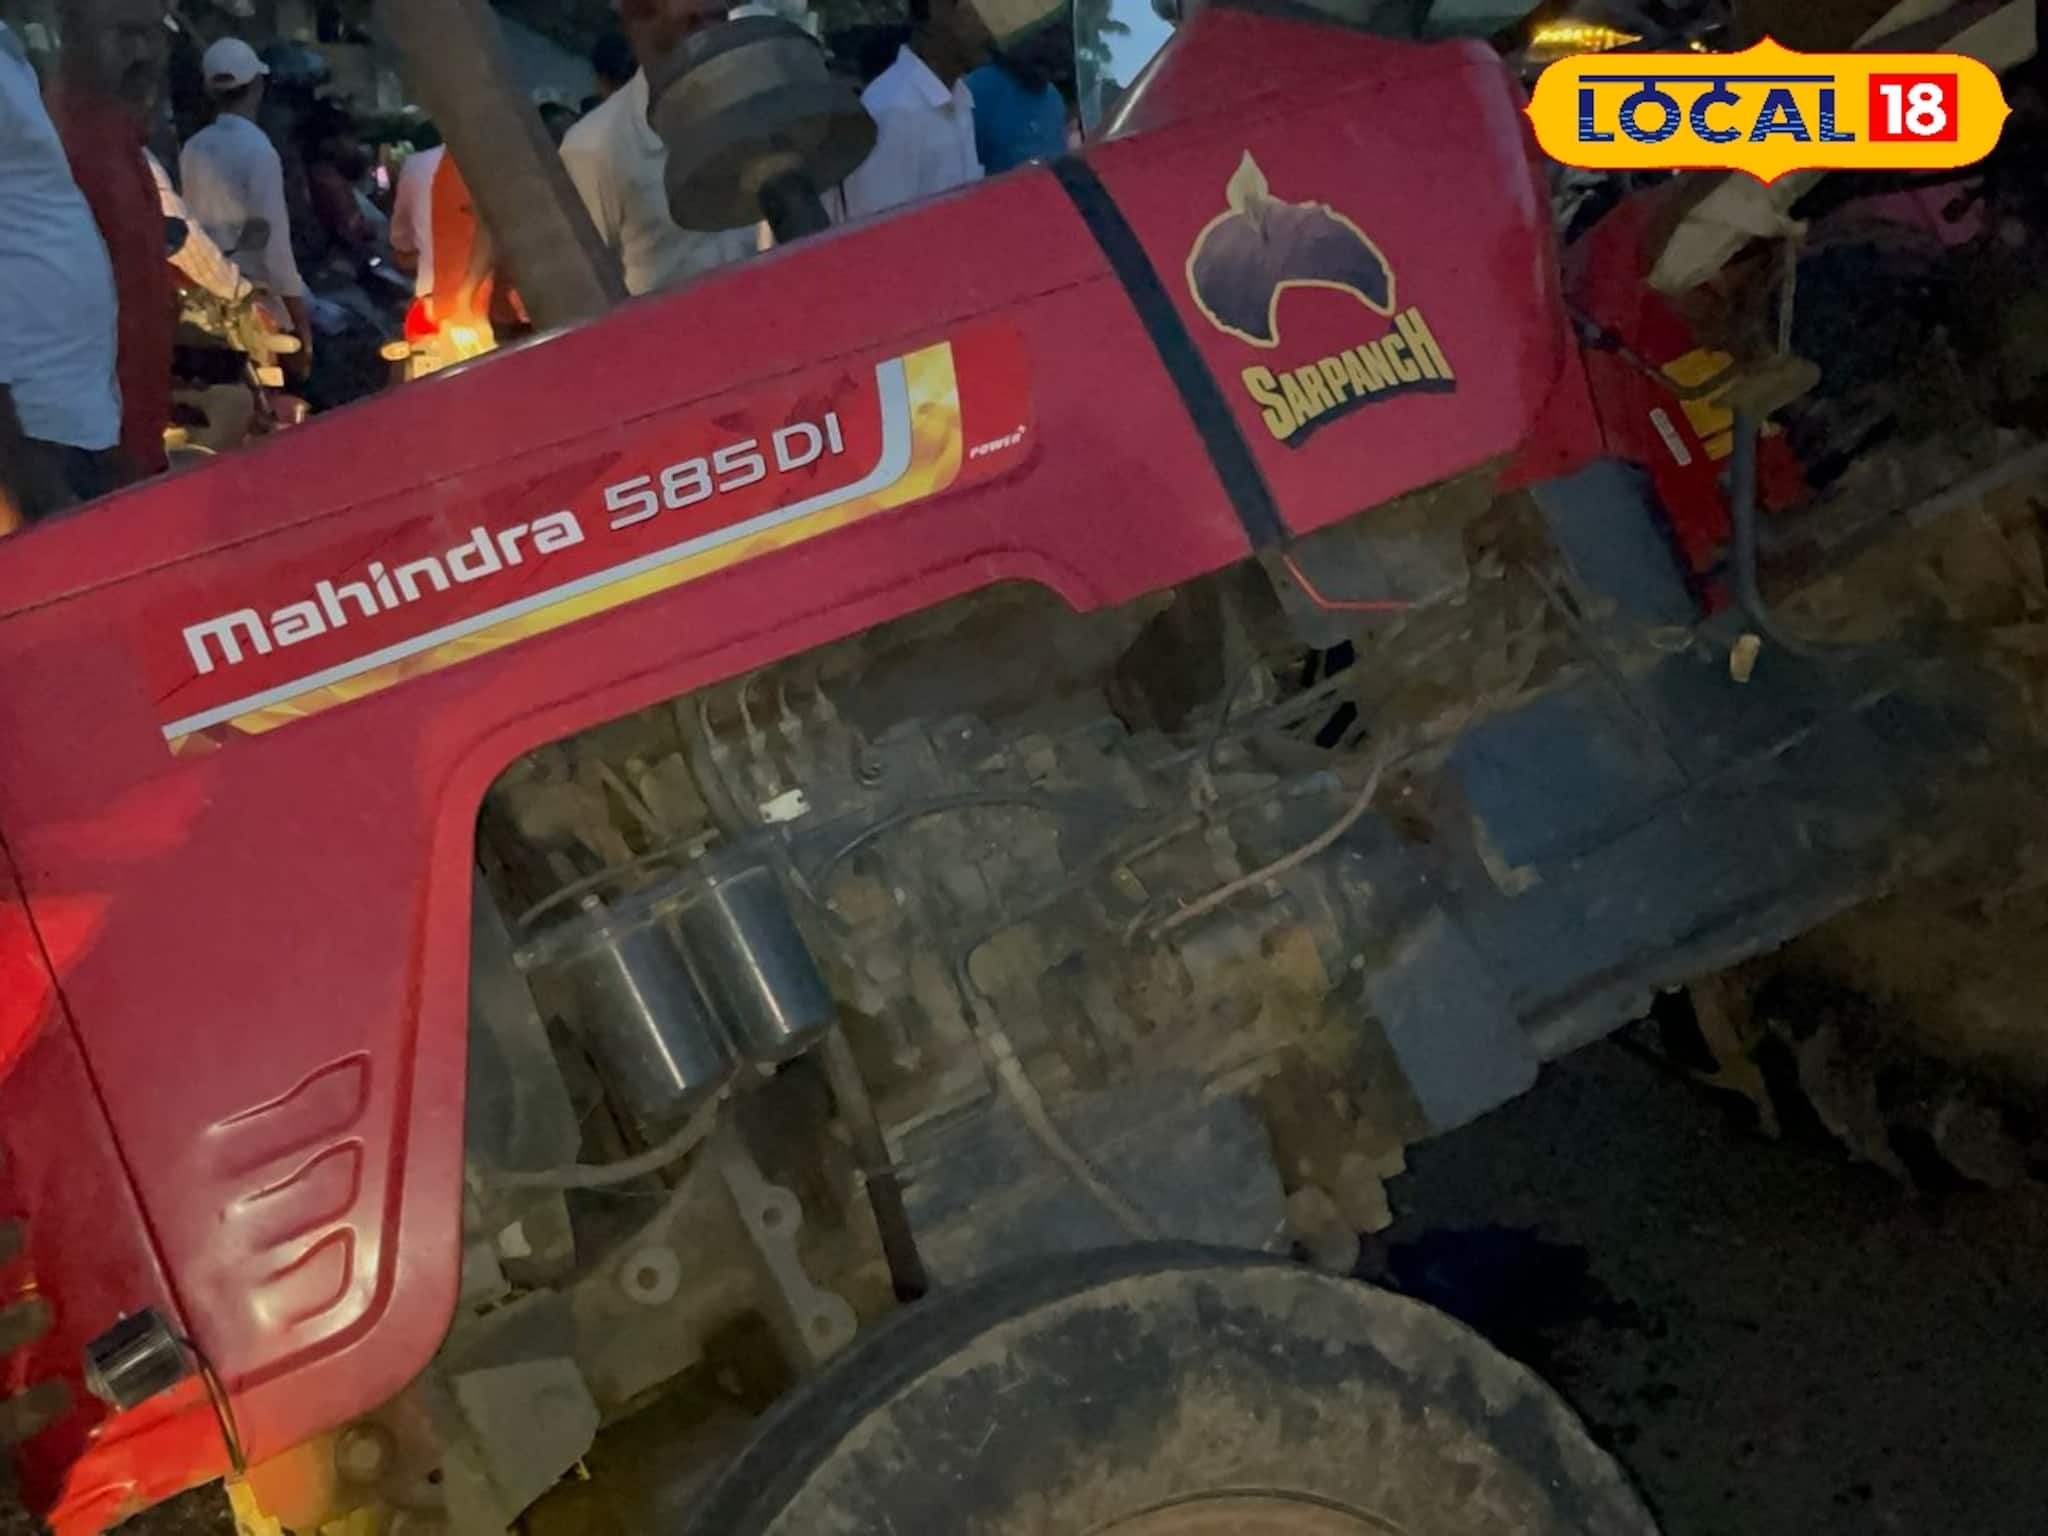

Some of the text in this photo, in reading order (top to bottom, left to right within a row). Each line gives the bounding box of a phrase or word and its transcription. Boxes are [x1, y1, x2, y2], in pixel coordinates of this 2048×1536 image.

[1241, 307, 1456, 441] SARPANCH
[182, 412, 844, 675] Mahindra 585 DI
